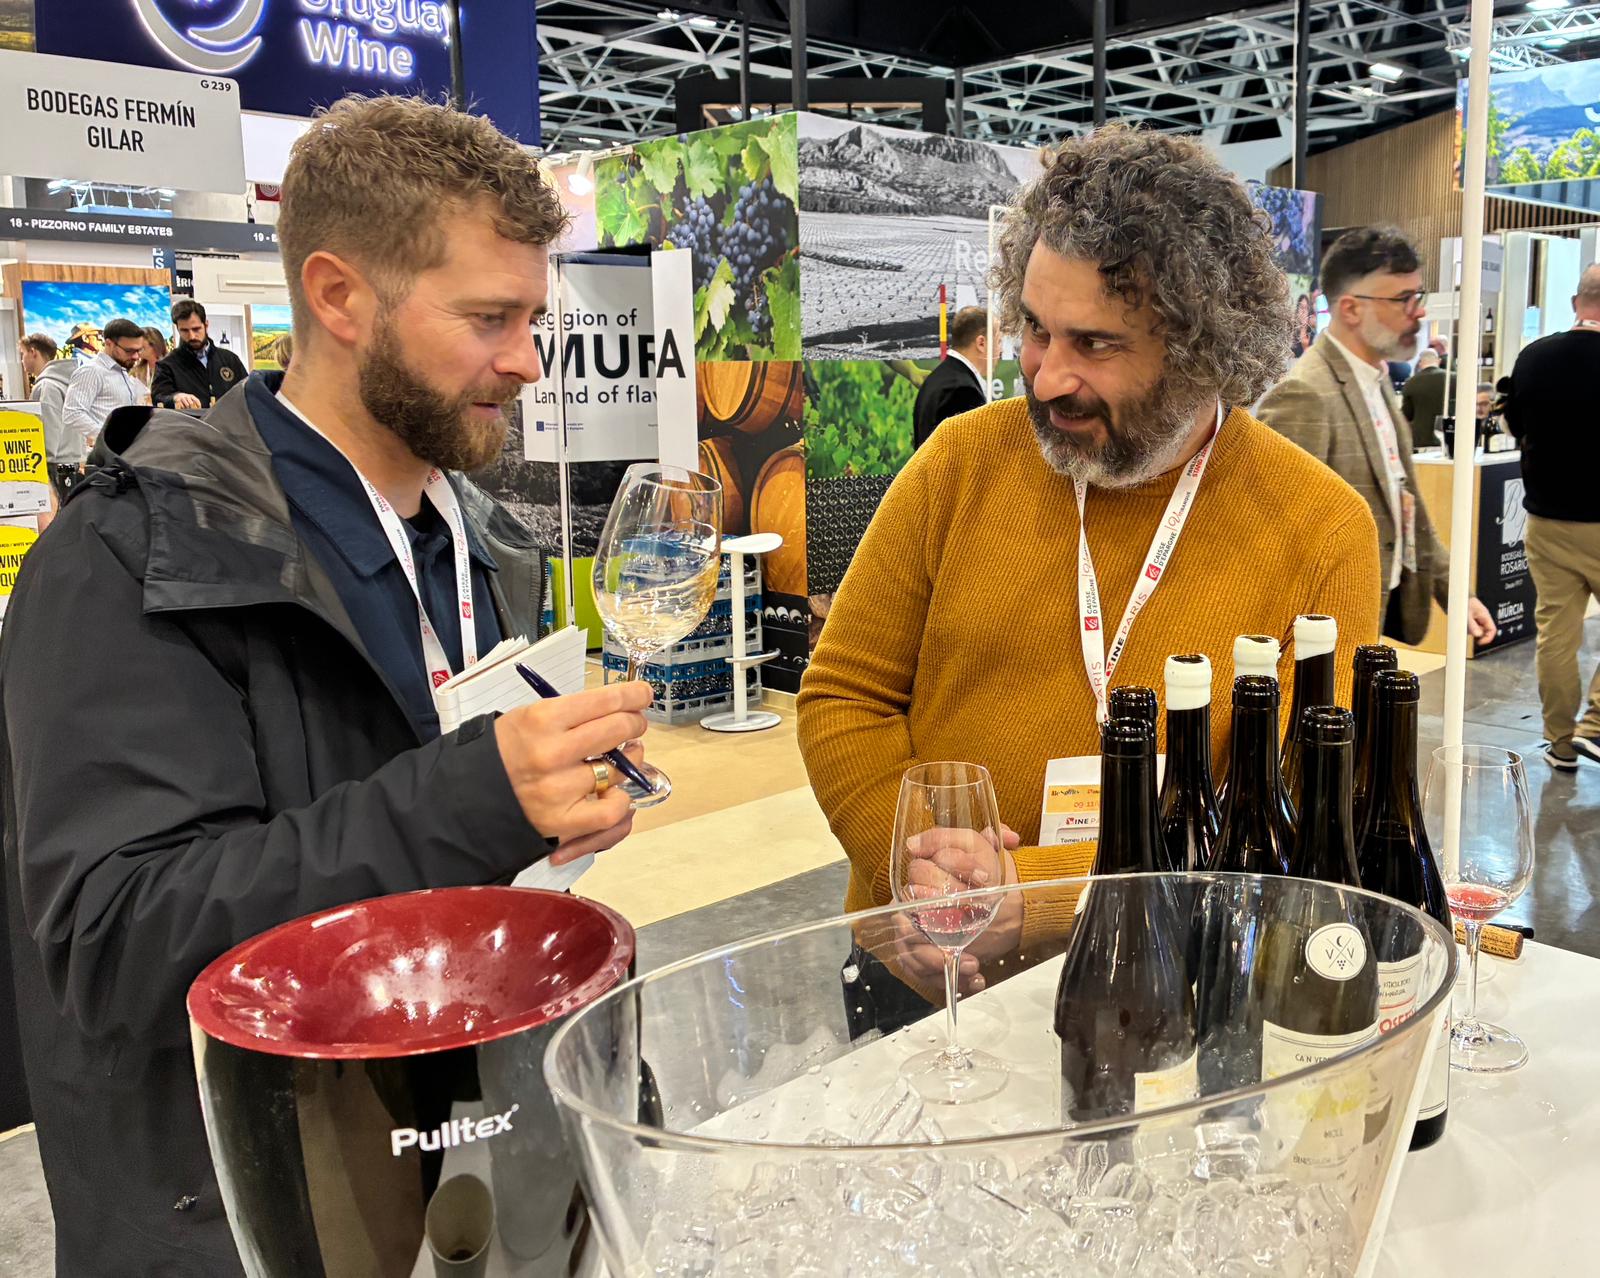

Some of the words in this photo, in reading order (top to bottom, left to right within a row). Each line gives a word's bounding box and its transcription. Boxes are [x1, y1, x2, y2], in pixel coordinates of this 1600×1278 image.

[300, 18, 414, 78] Wine
[200, 79, 209, 89] G
[211, 81, 231, 92] 239
[27, 88, 118, 119] BODEGAS
[125, 99, 196, 128] FERMÍN
[87, 126, 145, 152] GILAR
[9, 218, 23, 228] 18
[31, 219, 87, 232] PIZZORNO
[88, 223, 125, 234] FAMILY
[127, 225, 173, 237] ESTATES
[616, 308, 638, 327] of
[597, 385, 619, 404] of
[4, 440, 32, 455] WINE
[9, 453, 42, 474] QUÉ?
[1153, 541, 1166, 564] CAISSE
[1121, 592, 1148, 636] PARIS
[1091, 660, 1104, 703] ARIS
[390, 1104, 520, 1157] Pulltex
